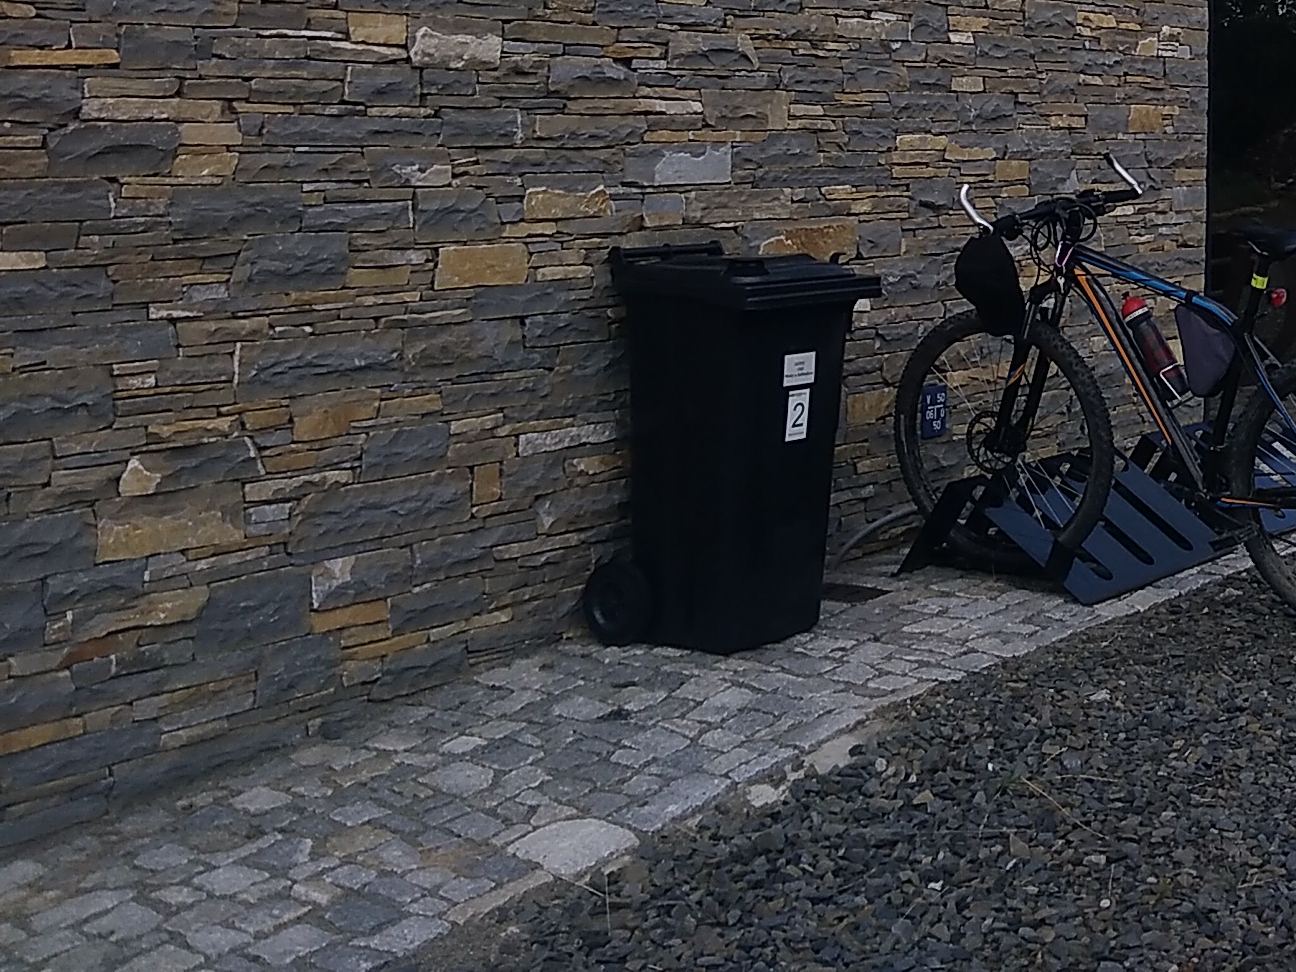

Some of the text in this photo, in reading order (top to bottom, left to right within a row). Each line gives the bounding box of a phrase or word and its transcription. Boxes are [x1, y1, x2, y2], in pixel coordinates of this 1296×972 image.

[936, 392, 946, 403] 50
[791, 402, 806, 429] 2
[932, 420, 942, 430] 50
